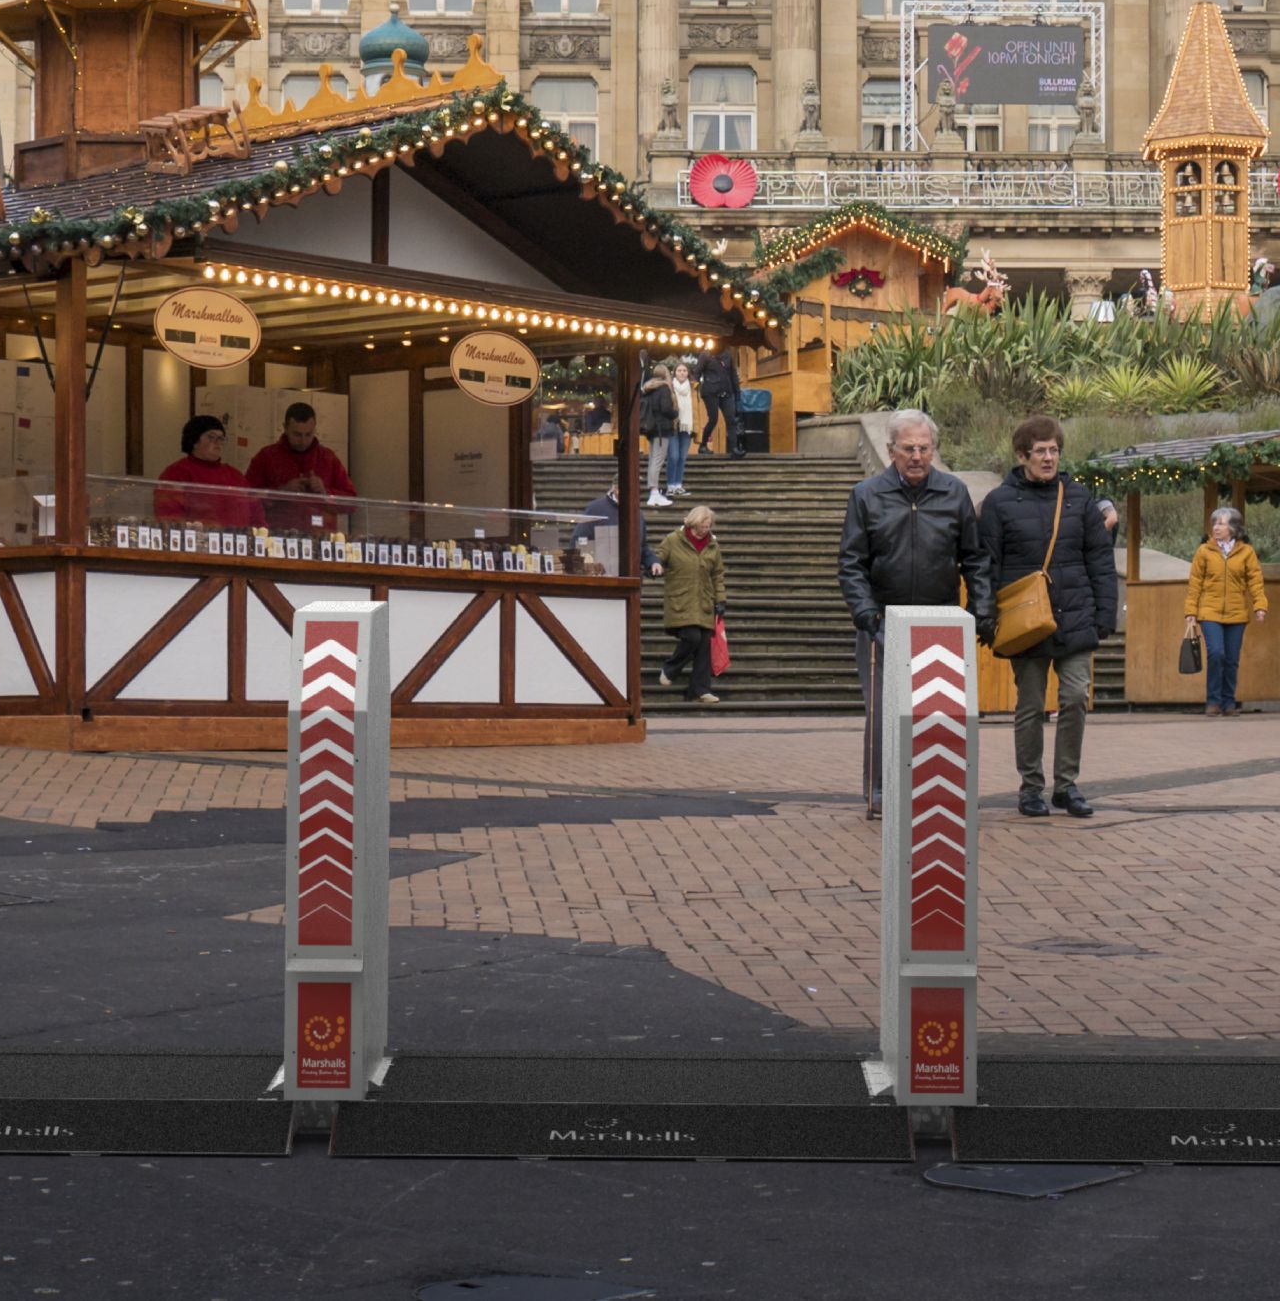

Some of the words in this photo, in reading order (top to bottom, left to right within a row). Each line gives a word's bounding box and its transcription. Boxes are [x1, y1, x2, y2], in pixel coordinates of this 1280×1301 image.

[1005, 40, 1040, 53] OPEN
[1044, 41, 1076, 53] UNTIL
[988, 52, 1018, 64] 10PM
[1021, 52, 1076, 65] TONIGHT
[828, 174, 1073, 206] CHRISTMAS
[171, 300, 244, 324] Marshmallow
[465, 343, 526, 365] Marshmallow
[302, 1057, 346, 1068] Marshalls
[915, 1062, 960, 1073] Marshalls
[549, 1130, 696, 1141] Marshalls
